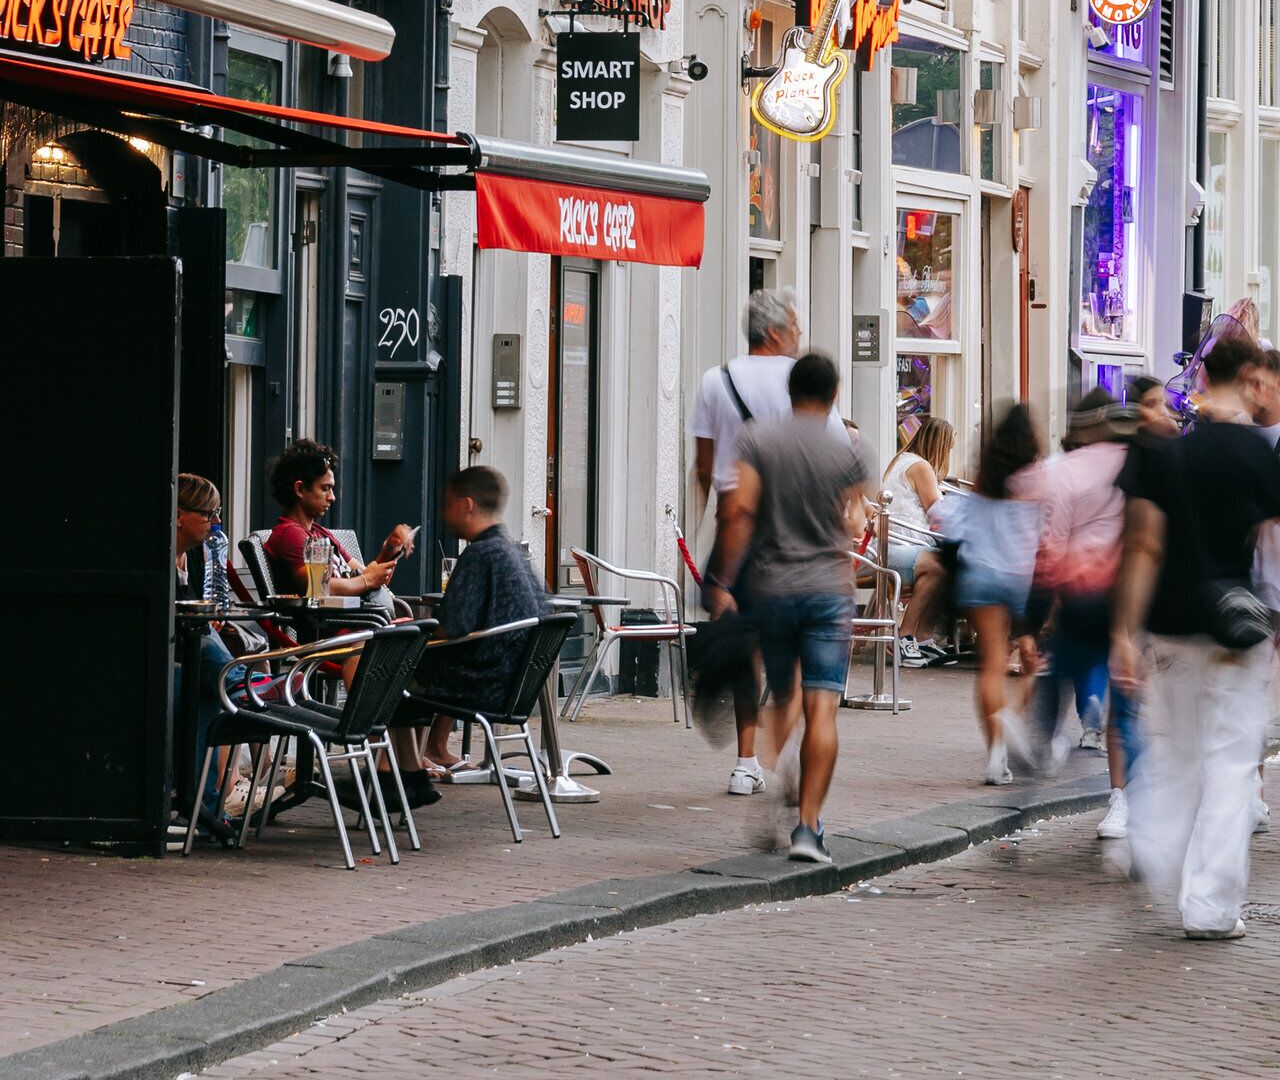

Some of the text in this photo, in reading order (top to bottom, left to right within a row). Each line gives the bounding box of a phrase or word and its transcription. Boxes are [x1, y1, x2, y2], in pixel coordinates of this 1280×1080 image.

[561, 60, 635, 80] SMART
[569, 91, 626, 110] SHOP
[558, 196, 598, 247] RICK'S
[378, 307, 421, 357] 250
